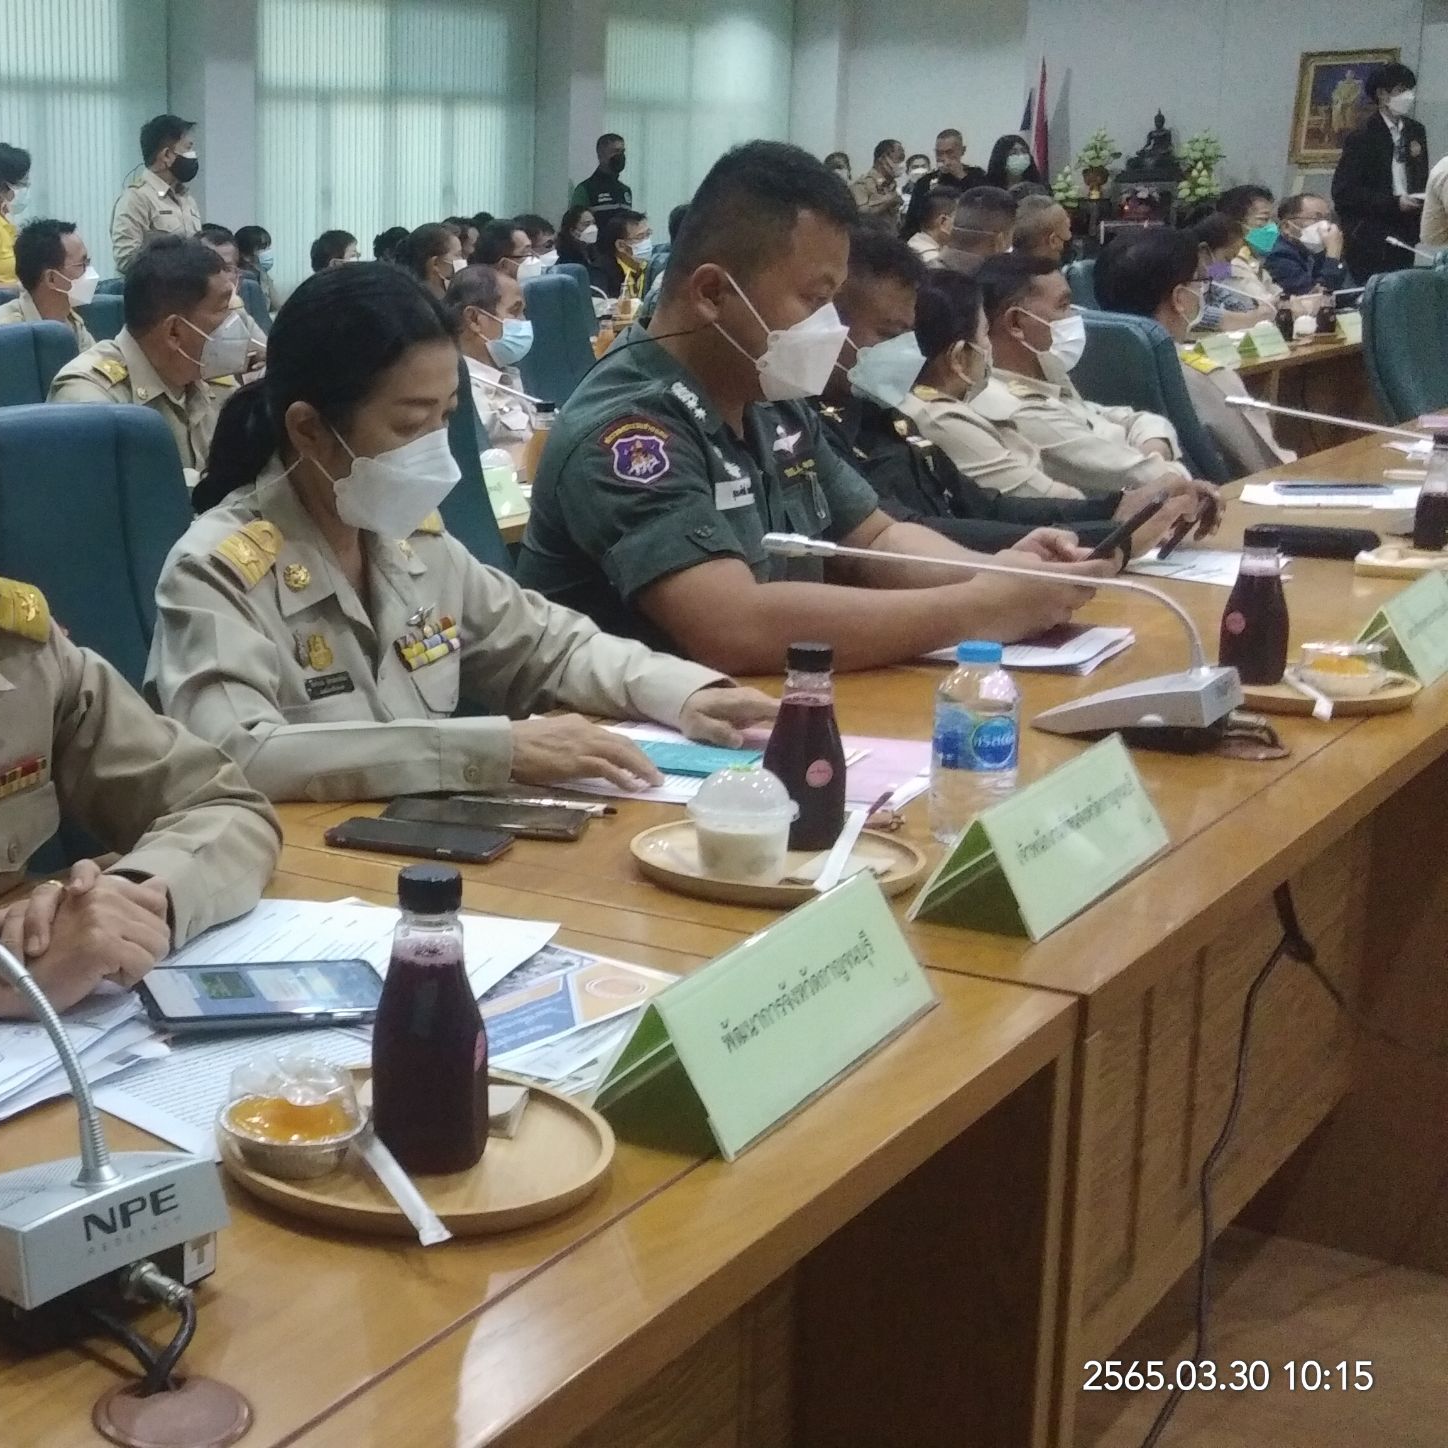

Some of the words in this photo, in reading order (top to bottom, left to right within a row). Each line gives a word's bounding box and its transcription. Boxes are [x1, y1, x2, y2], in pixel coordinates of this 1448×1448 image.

[720, 928, 875, 1054] พัฒนาการจังหวัดกาญจนบุรี
[81, 1182, 180, 1243] NPE
